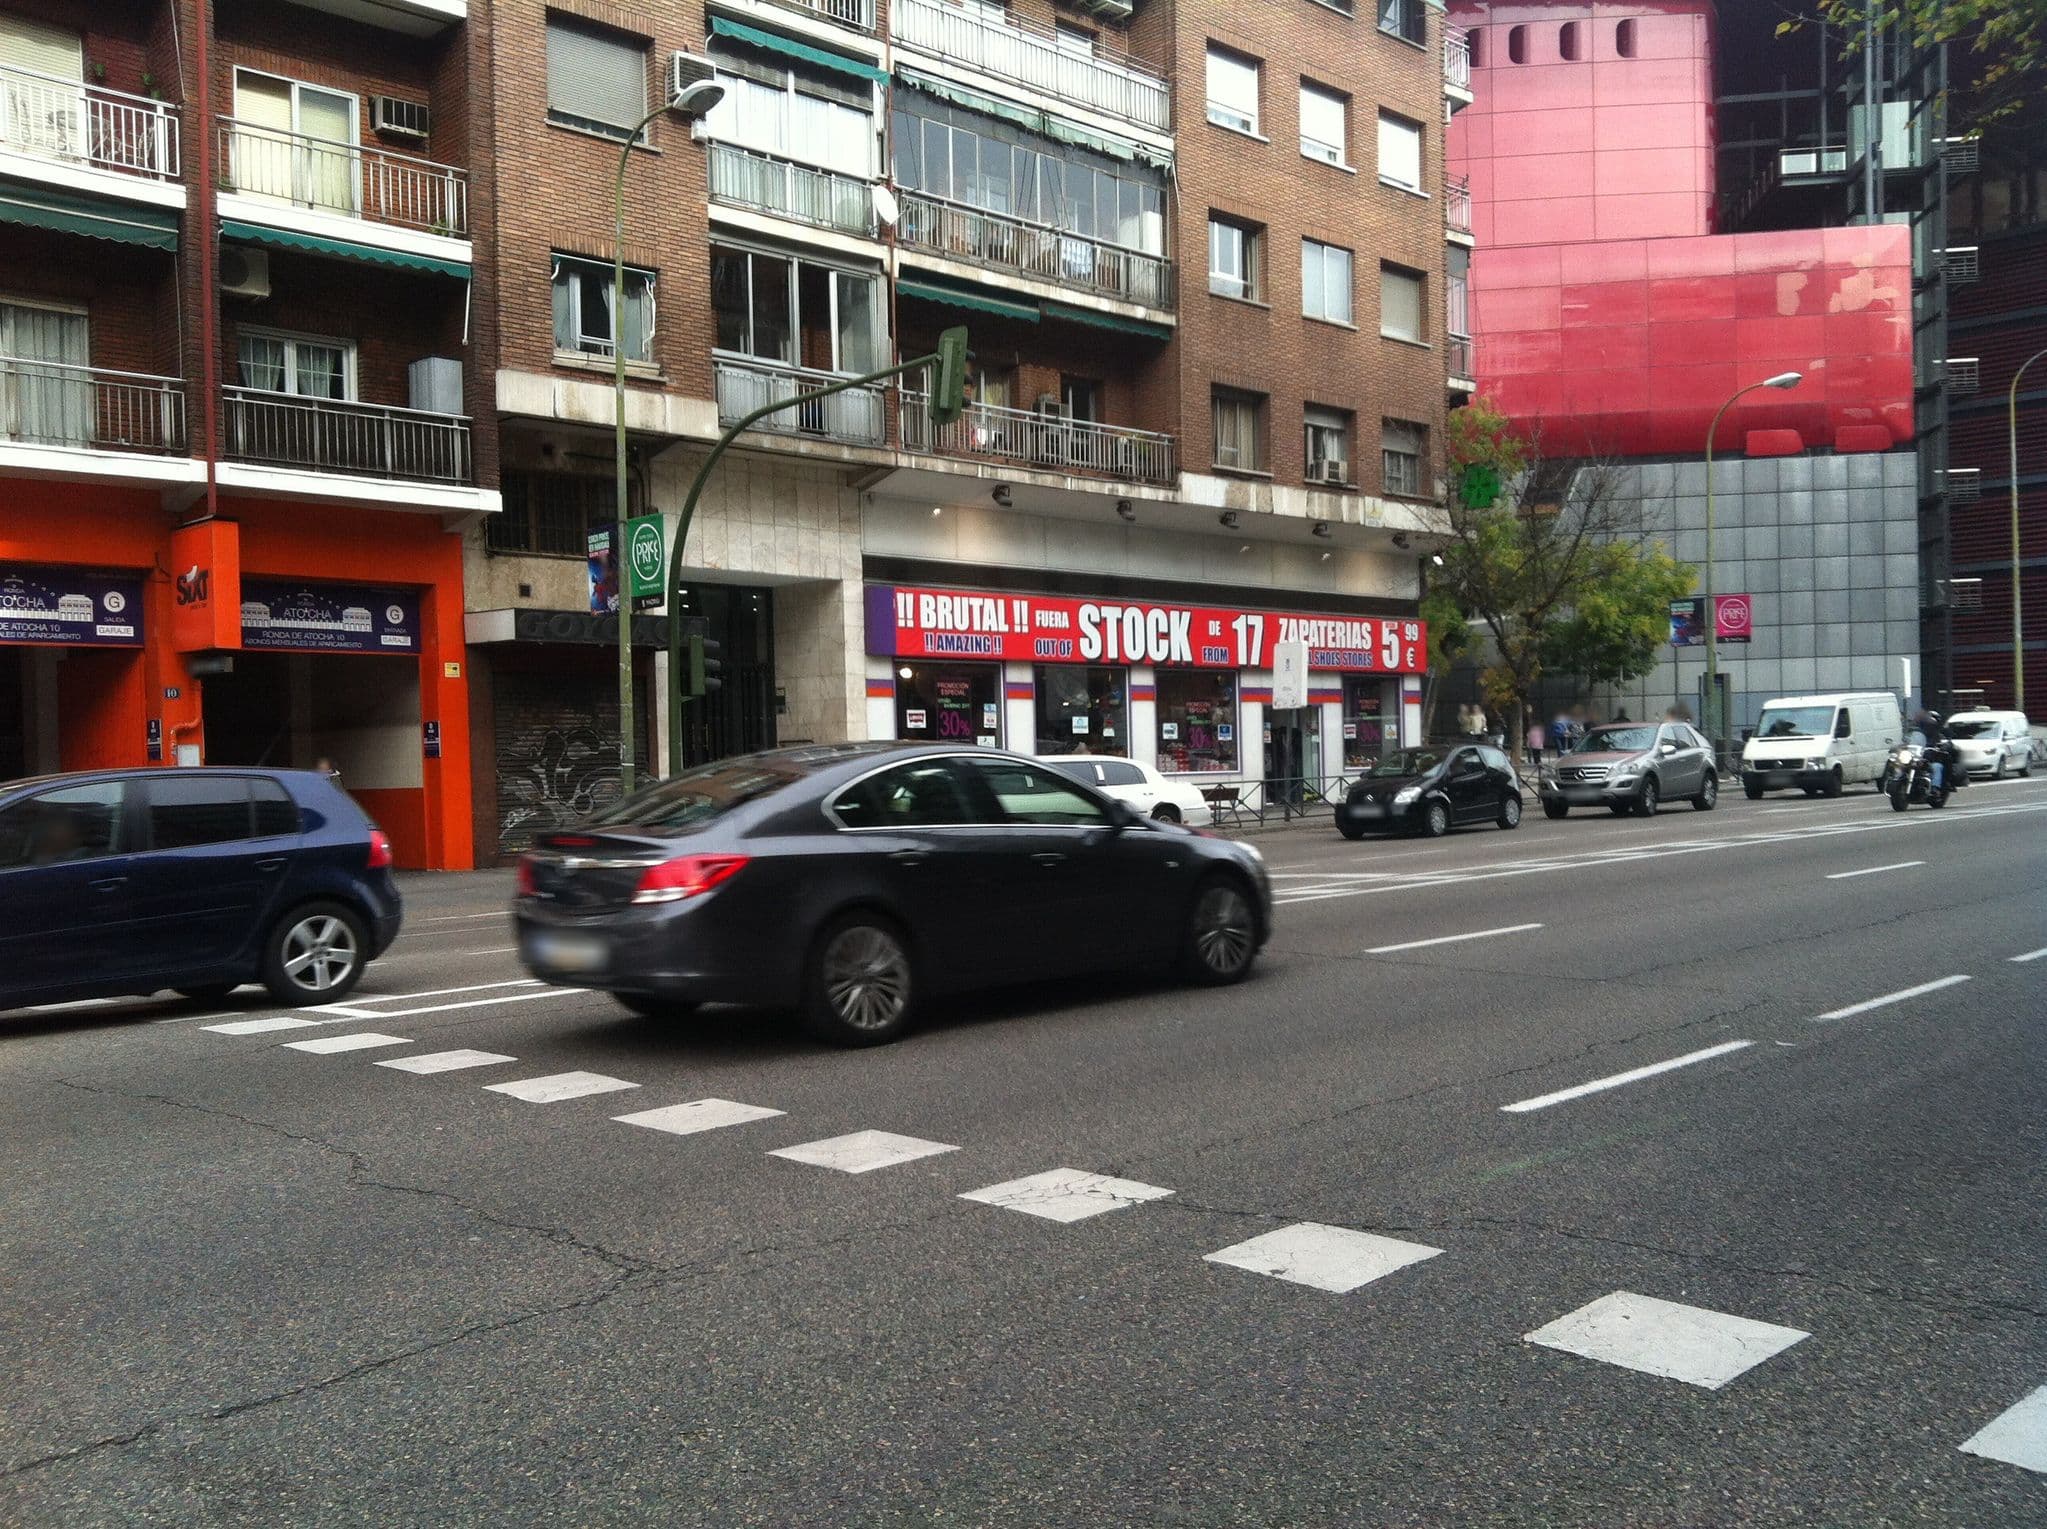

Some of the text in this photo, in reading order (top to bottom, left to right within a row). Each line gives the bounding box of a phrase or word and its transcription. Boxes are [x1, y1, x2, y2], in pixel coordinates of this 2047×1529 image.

[11, 622, 48, 632] ATOCHA
[50, 624, 60, 633] 10
[98, 626, 132, 635] GARAJE
[262, 630, 290, 639] RONDA
[292, 631, 302, 640] DE
[304, 632, 334, 641] ATOCHA
[896, 592, 914, 628] !!
[919, 594, 1009, 633] BRUTAL
[1012, 600, 1029, 633] !!
[1035, 609, 1070, 629] FUERA
[1078, 603, 1193, 662] STOCK
[1208, 620, 1221, 636] DE
[1231, 614, 1264, 666] 17
[1279, 618, 1373, 650] ZAPATERIAS
[1382, 621, 1399, 669] 5
[1404, 623, 1418, 641] 99
[936, 633, 991, 654] AMAZING
[1034, 638, 1058, 657] OUT
[1059, 639, 1073, 657] OF
[1202, 646, 1229, 664] FROM
[1315, 651, 1341, 666] SHOES
[1343, 652, 1373, 668] STORES
[1406, 647, 1415, 668] €
[166, 688, 178, 698] 10
[939, 711, 970, 737] 30%
